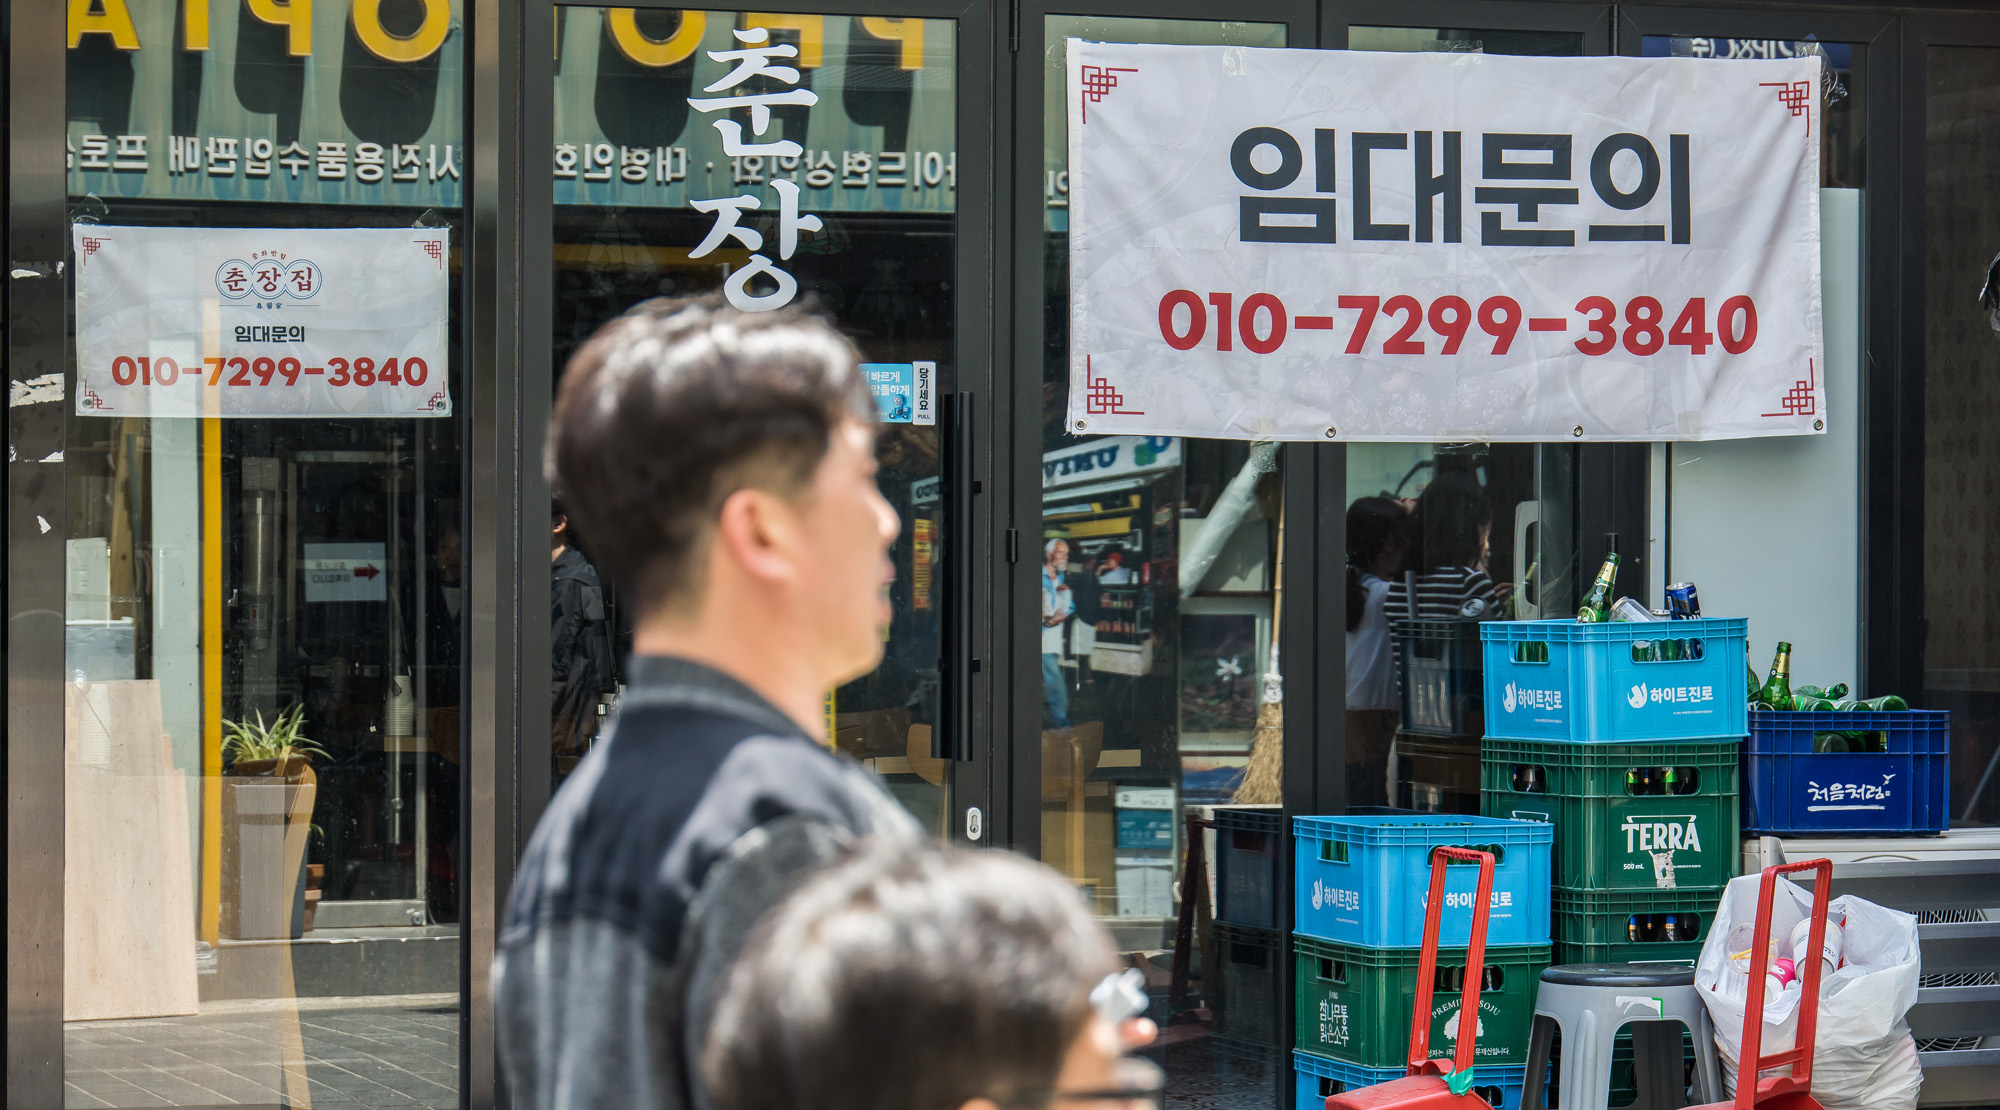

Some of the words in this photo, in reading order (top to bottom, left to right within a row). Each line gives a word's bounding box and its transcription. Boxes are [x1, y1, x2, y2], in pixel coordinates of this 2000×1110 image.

[1229, 126, 1692, 247] 임대문의
[222, 266, 313, 292] 춘장집
[234, 326, 305, 343] 임대문의
[1157, 289, 1760, 356] 010-7299-3840
[112, 356, 429, 388] 010-7299-3840
[870, 370, 901, 383] 빠르게
[919, 367, 930, 411] 당기세요
[1518, 688, 1563, 711] 하이트진로
[1650, 686, 1714, 704] 하이트진로
[1807, 781, 1885, 802] 처음처럼
[1621, 821, 1702, 854] TERRA
[1323, 886, 1360, 911] 하이트진로
[1445, 891, 1513, 909] 하이진로
[1319, 998, 1349, 1026] 참나무통
[1431, 998, 1462, 1019] PREMI
[1478, 999, 1501, 1017] SOJU
[1320, 1023, 1350, 1048] 맑은소주
[1474, 1047, 1511, 1056] 유재산입니다.
